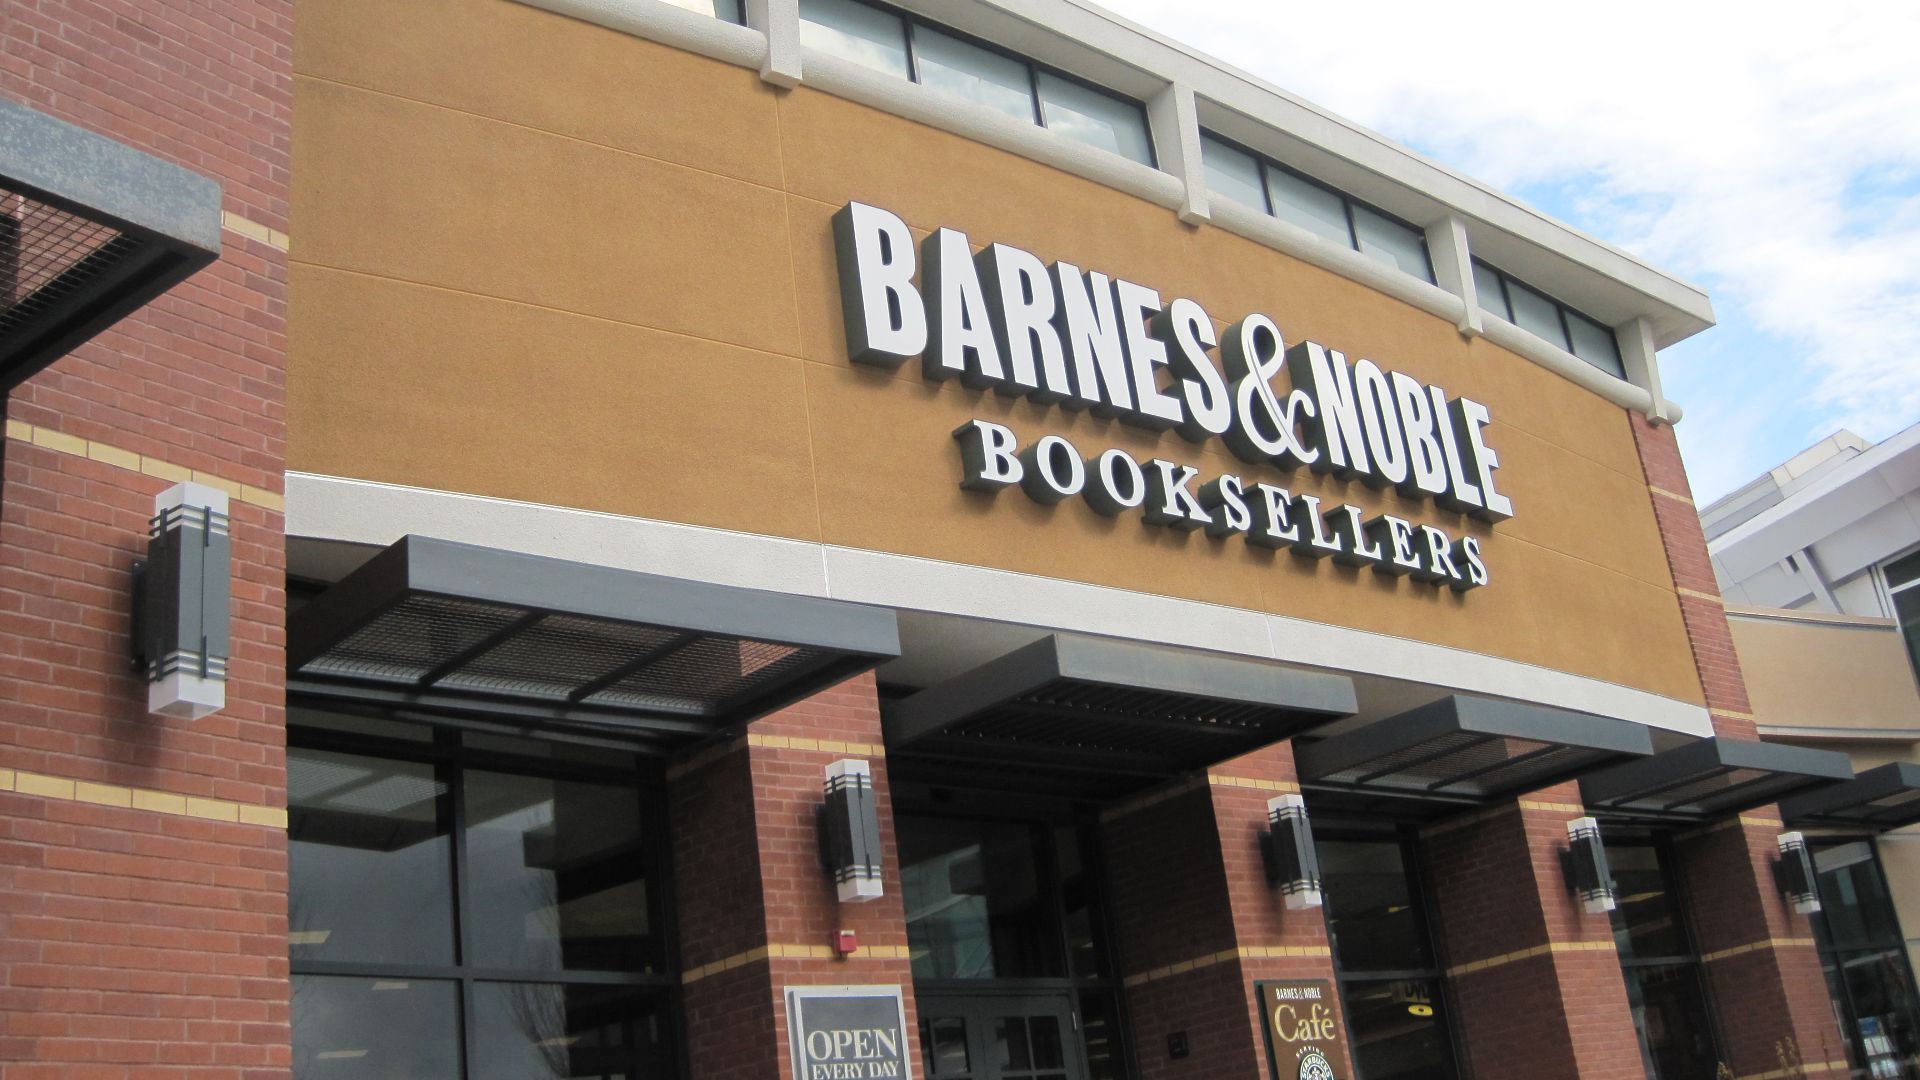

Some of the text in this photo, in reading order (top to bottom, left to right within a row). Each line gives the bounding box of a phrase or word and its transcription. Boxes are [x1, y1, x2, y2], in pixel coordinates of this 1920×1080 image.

[849, 201, 1514, 519] BARNES & NOBLE
[971, 419, 1489, 587] BOOKSELLERS
[1274, 1003, 1336, 1042] Café
[807, 1028, 897, 1061] OPEN
[811, 1060, 900, 1080] EVERY DAY
